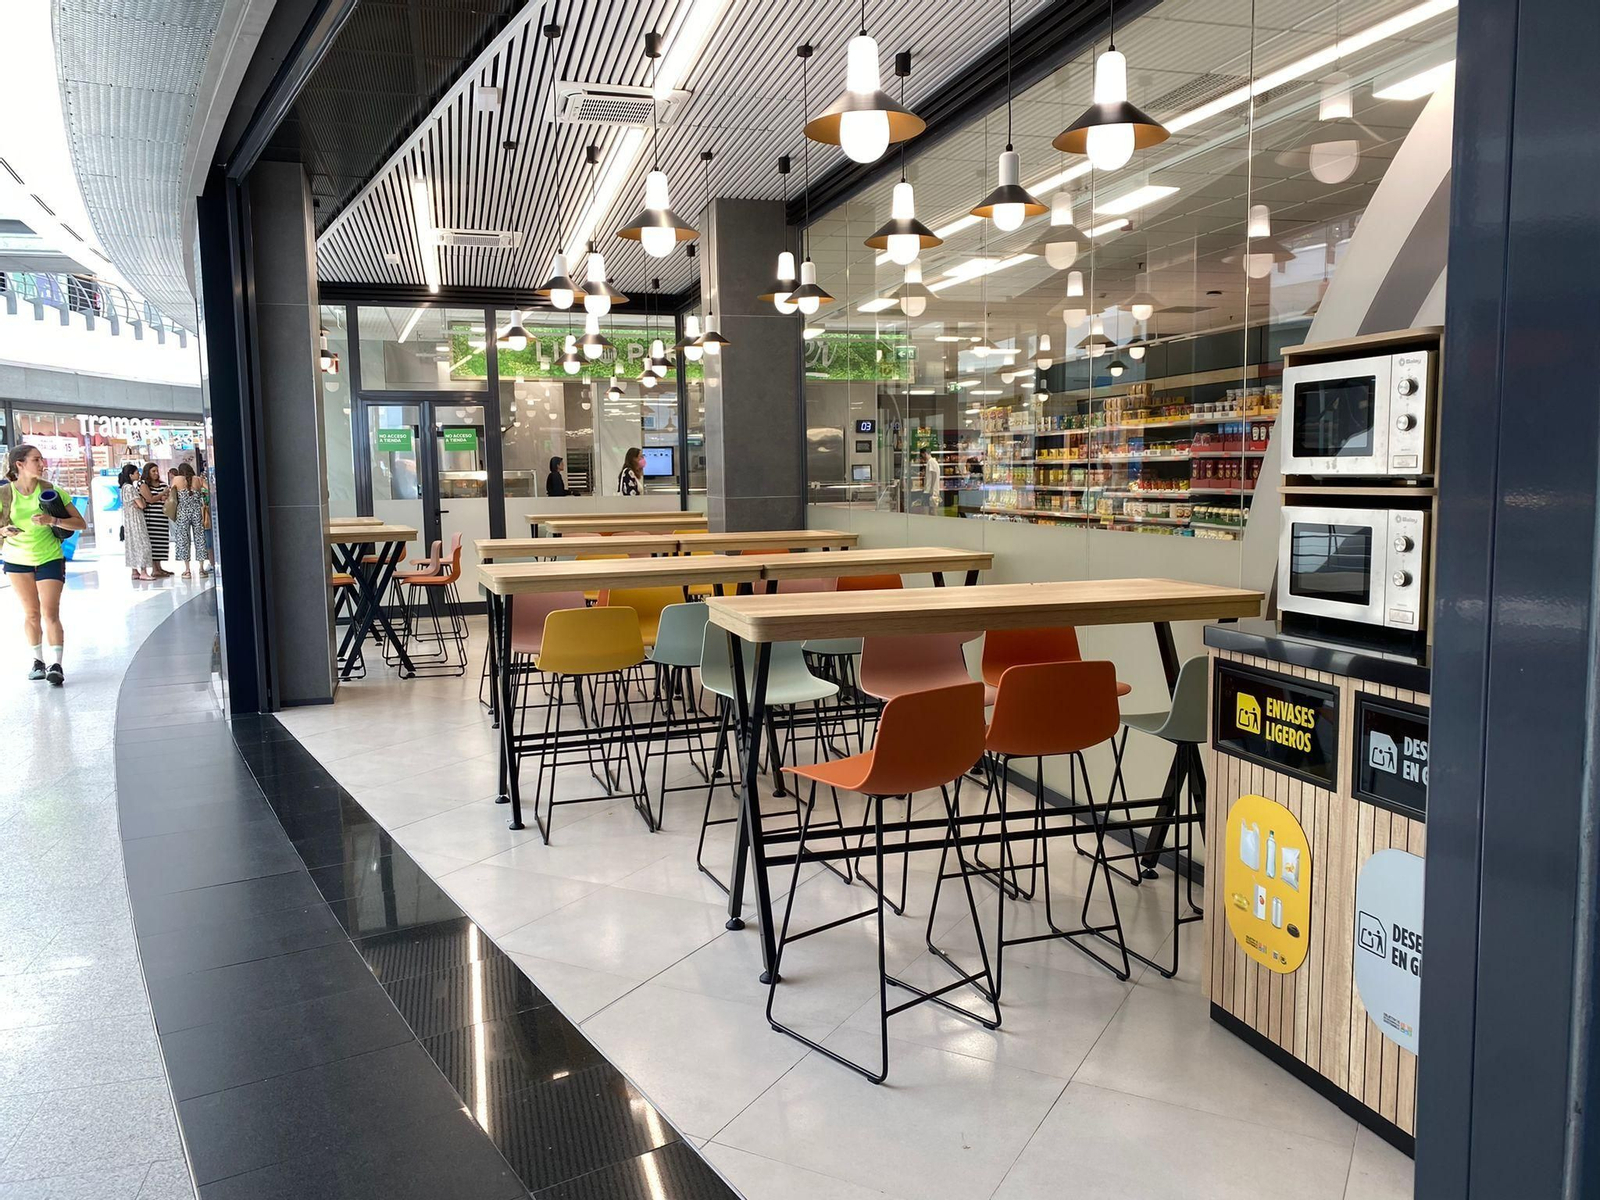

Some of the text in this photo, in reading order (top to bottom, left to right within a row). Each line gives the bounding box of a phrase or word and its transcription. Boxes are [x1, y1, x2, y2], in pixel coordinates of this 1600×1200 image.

[860, 422, 872, 431] 03
[1266, 696, 1315, 729] ENVASES
[1265, 720, 1312, 753] LIGEROS
[1403, 736, 1428, 761] DES
[1403, 759, 1420, 783] EN
[1392, 923, 1422, 955] DESE
[1391, 946, 1407, 971] EN
